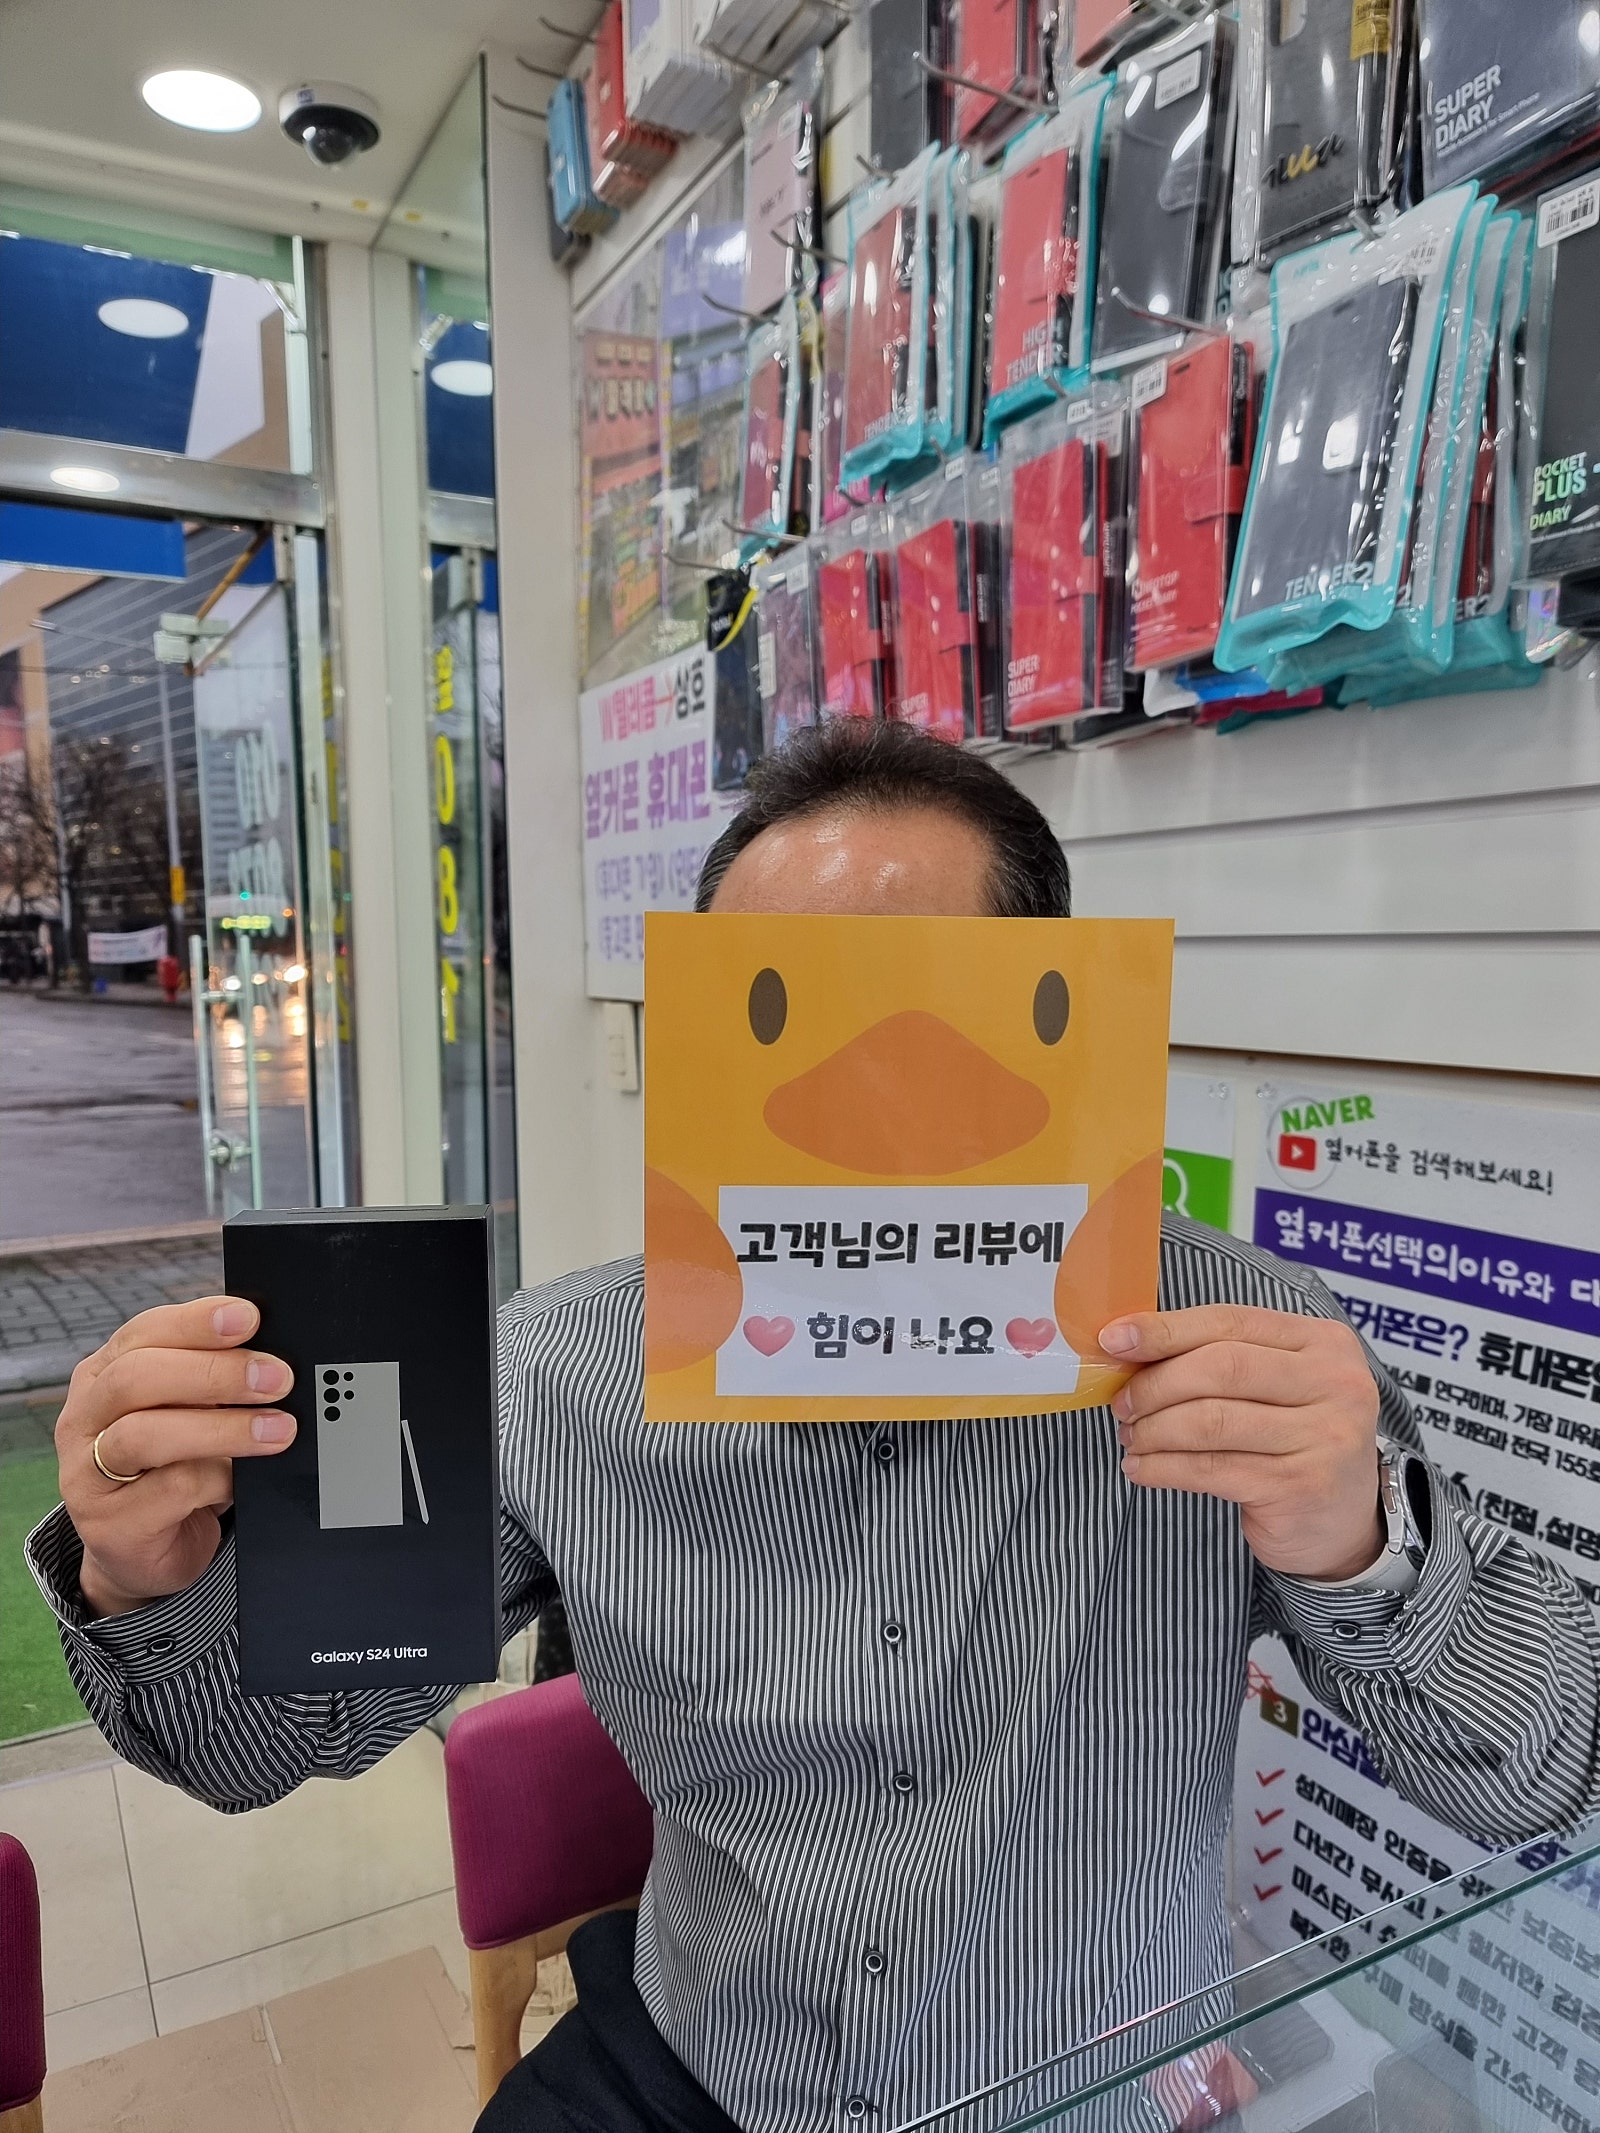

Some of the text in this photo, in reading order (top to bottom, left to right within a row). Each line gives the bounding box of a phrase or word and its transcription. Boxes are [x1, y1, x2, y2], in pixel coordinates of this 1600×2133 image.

[1434, 64, 1501, 123] SUPER
[1435, 94, 1494, 150] DIARY
[1532, 467, 1587, 506] PLUS
[1533, 451, 1587, 483] POCKET
[1530, 504, 1572, 531] DIARY
[1284, 561, 1374, 601] TENER2
[1008, 654, 1040, 679] SUPER
[1008, 675, 1036, 698] DIARY
[647, 738, 711, 830] 휴대폰
[1280, 1094, 1375, 1133] NAVER
[1324, 1136, 1554, 1196] 옆커폰을 검색해보세요!
[736, 1221, 1064, 1269] 고객님의 리뷰에
[806, 1311, 995, 1359] 힘이 나요
[1513, 1403, 1553, 1434] 가장
[1510, 1433, 1550, 1467] 전국
[311, 1646, 428, 1664] Galaxy S24 Ultra
[1272, 1699, 1289, 1724] 3
[1293, 1819, 1355, 1879] 다년간
